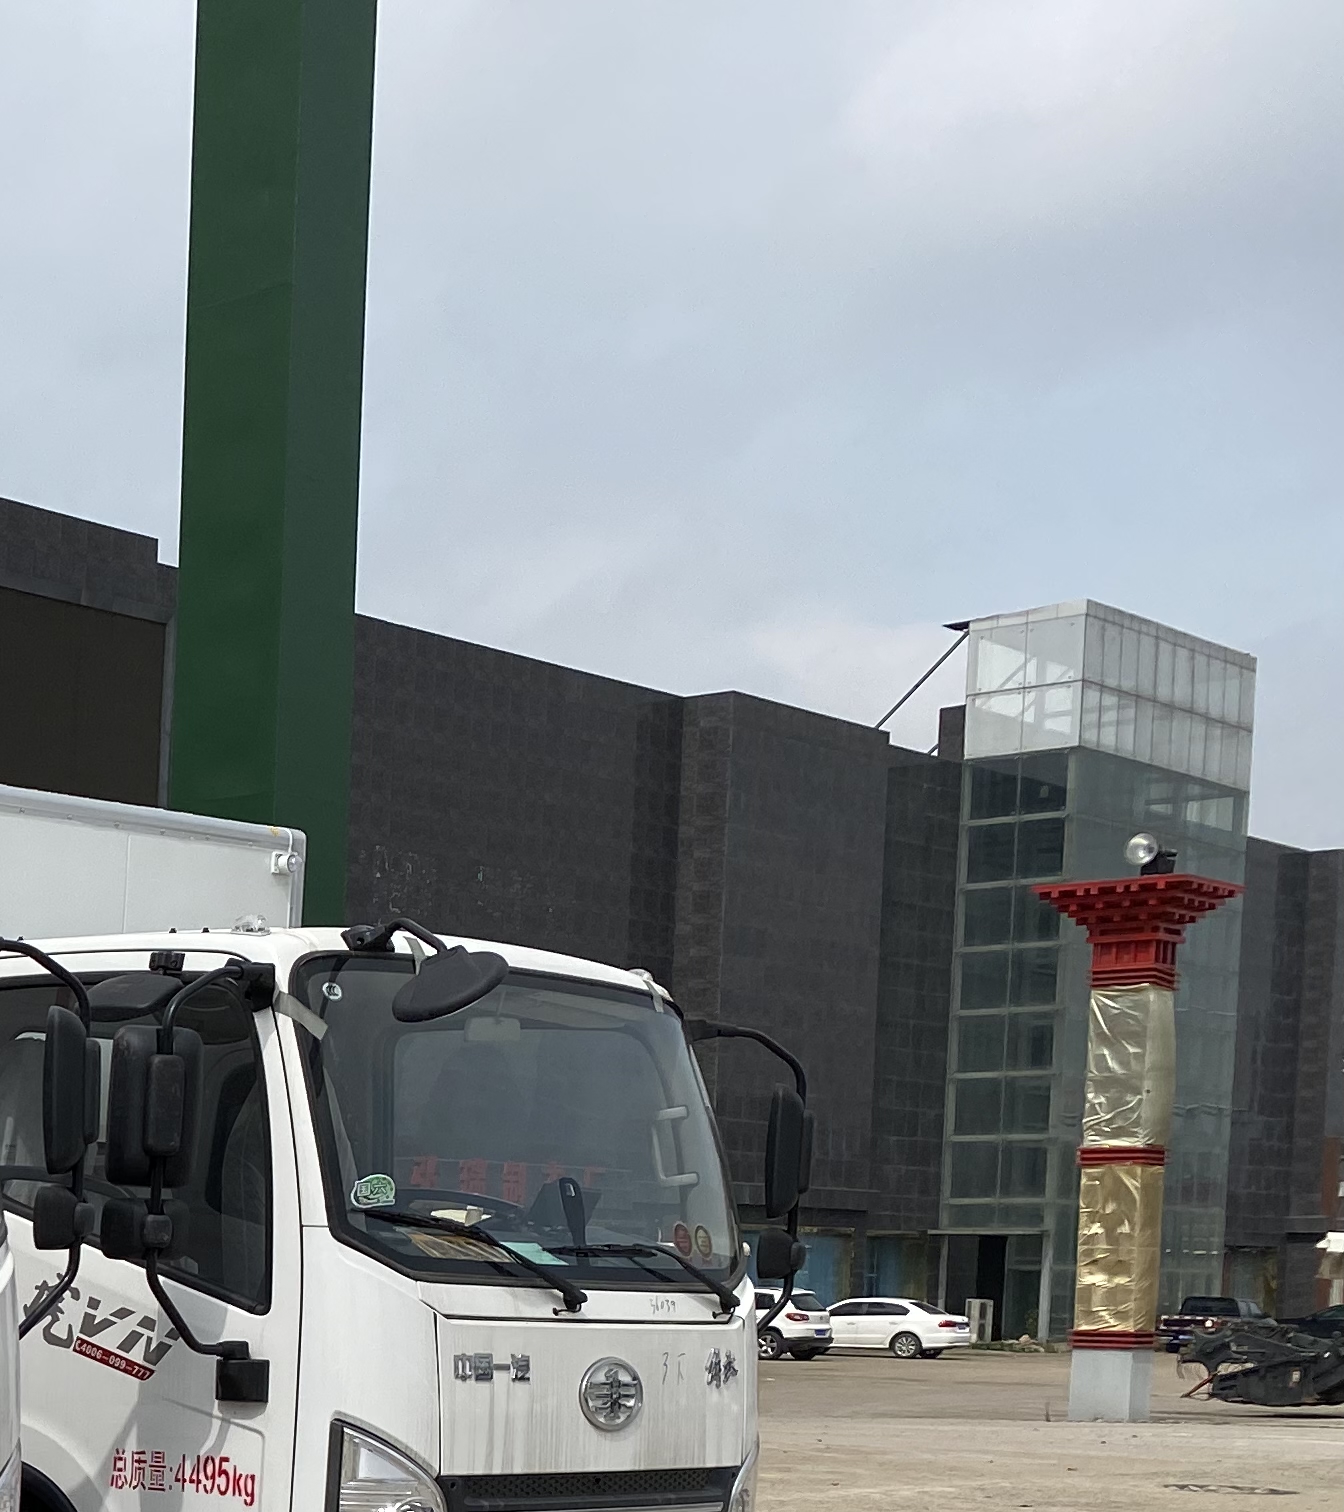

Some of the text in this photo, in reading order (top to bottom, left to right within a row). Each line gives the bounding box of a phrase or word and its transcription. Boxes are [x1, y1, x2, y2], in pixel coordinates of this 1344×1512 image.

[356, 1181, 388, 1197] 国六
[453, 1353, 531, 1382] 中国一汽
